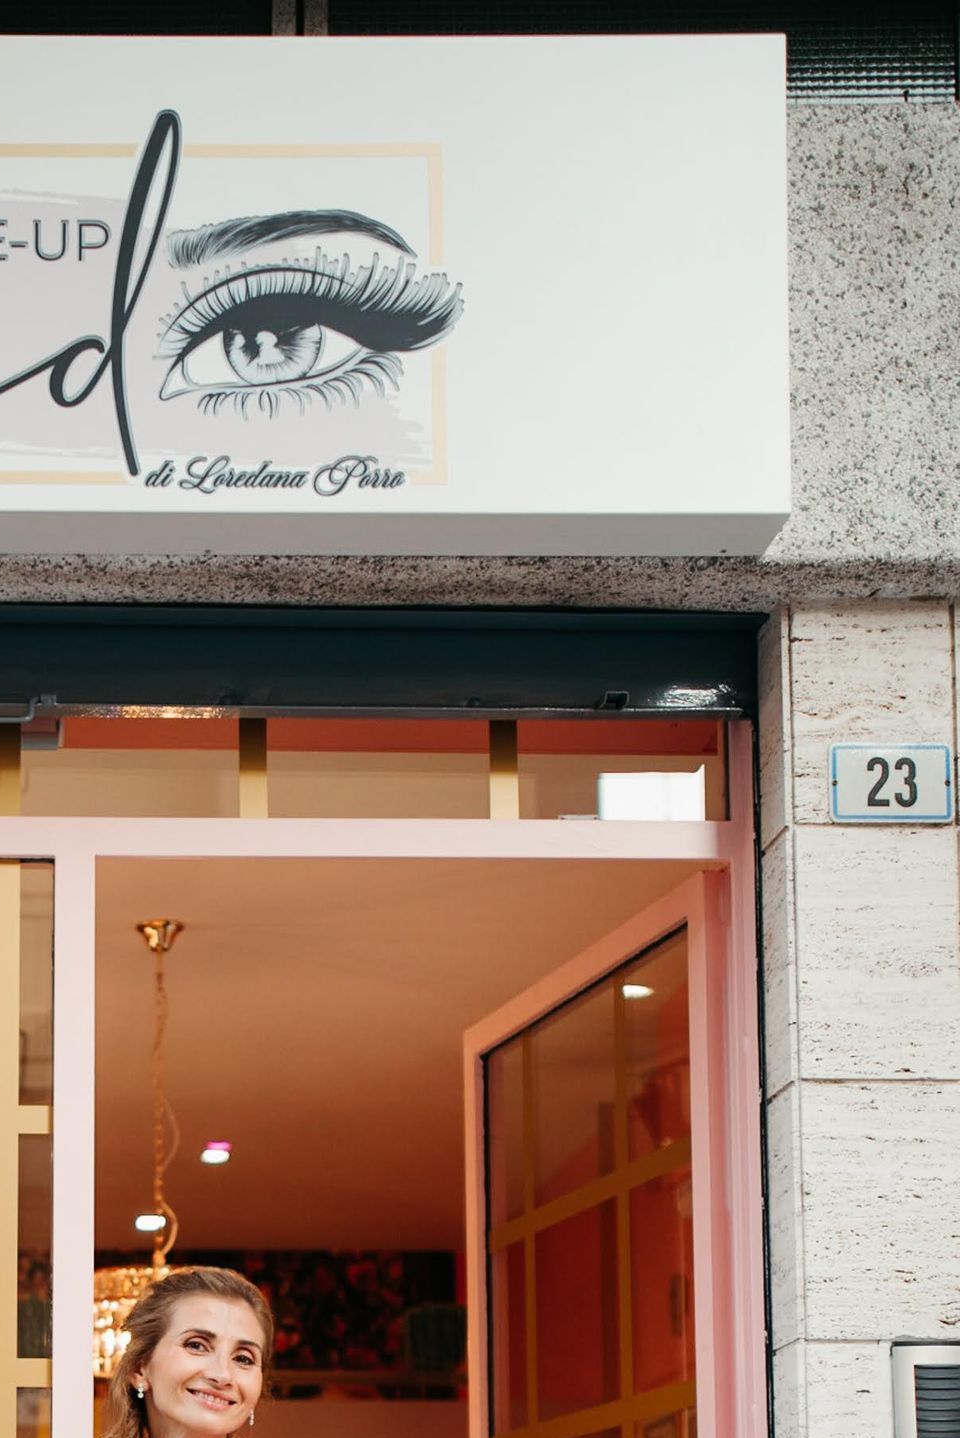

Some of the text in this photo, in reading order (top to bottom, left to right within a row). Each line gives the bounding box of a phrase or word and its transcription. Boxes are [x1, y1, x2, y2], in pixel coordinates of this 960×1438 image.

[144, 455, 406, 496] di Loredana Porro
[866, 756, 918, 808] 23
